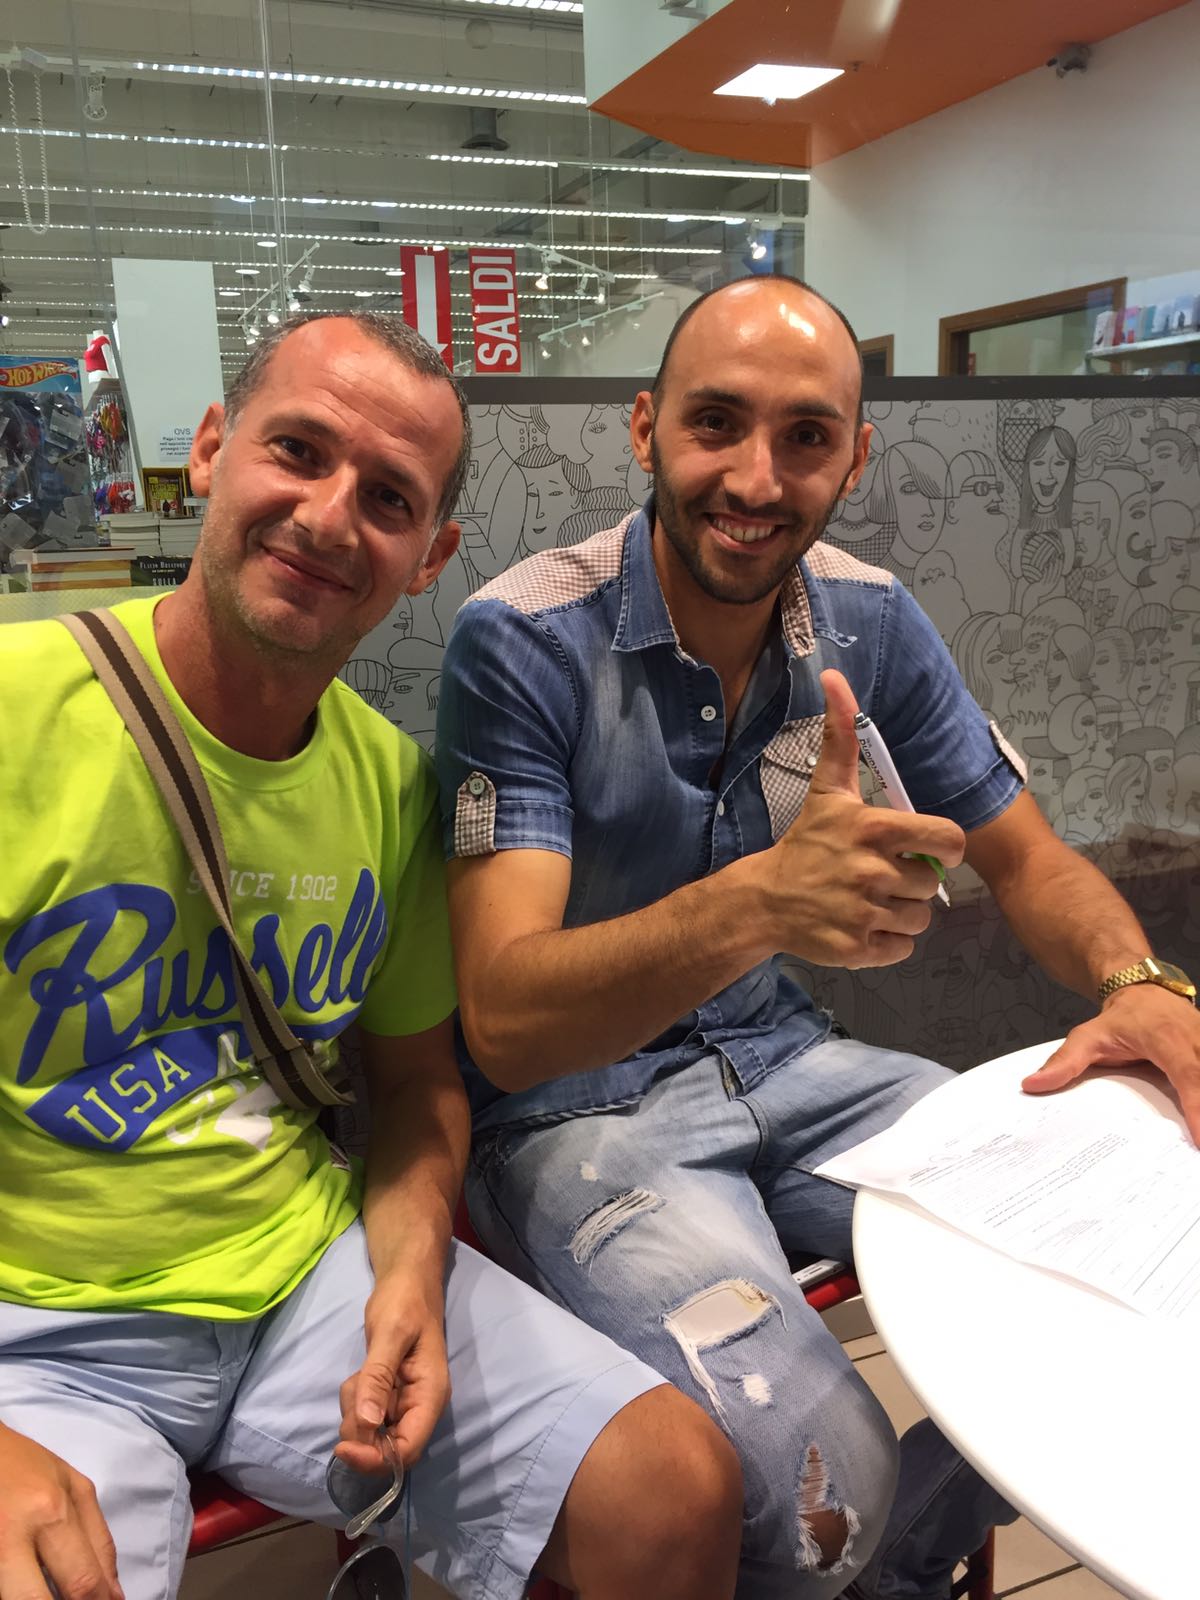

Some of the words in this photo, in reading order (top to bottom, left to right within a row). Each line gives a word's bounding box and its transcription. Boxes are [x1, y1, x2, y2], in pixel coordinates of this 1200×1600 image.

[472, 256, 518, 365] SALDI
[7, 367, 33, 387] HOT
[174, 427, 191, 435] OVS
[186, 869, 275, 899] SCE
[286, 873, 338, 901] 1902
[4, 868, 387, 1084] Russell
[64, 1048, 191, 1144] USA
